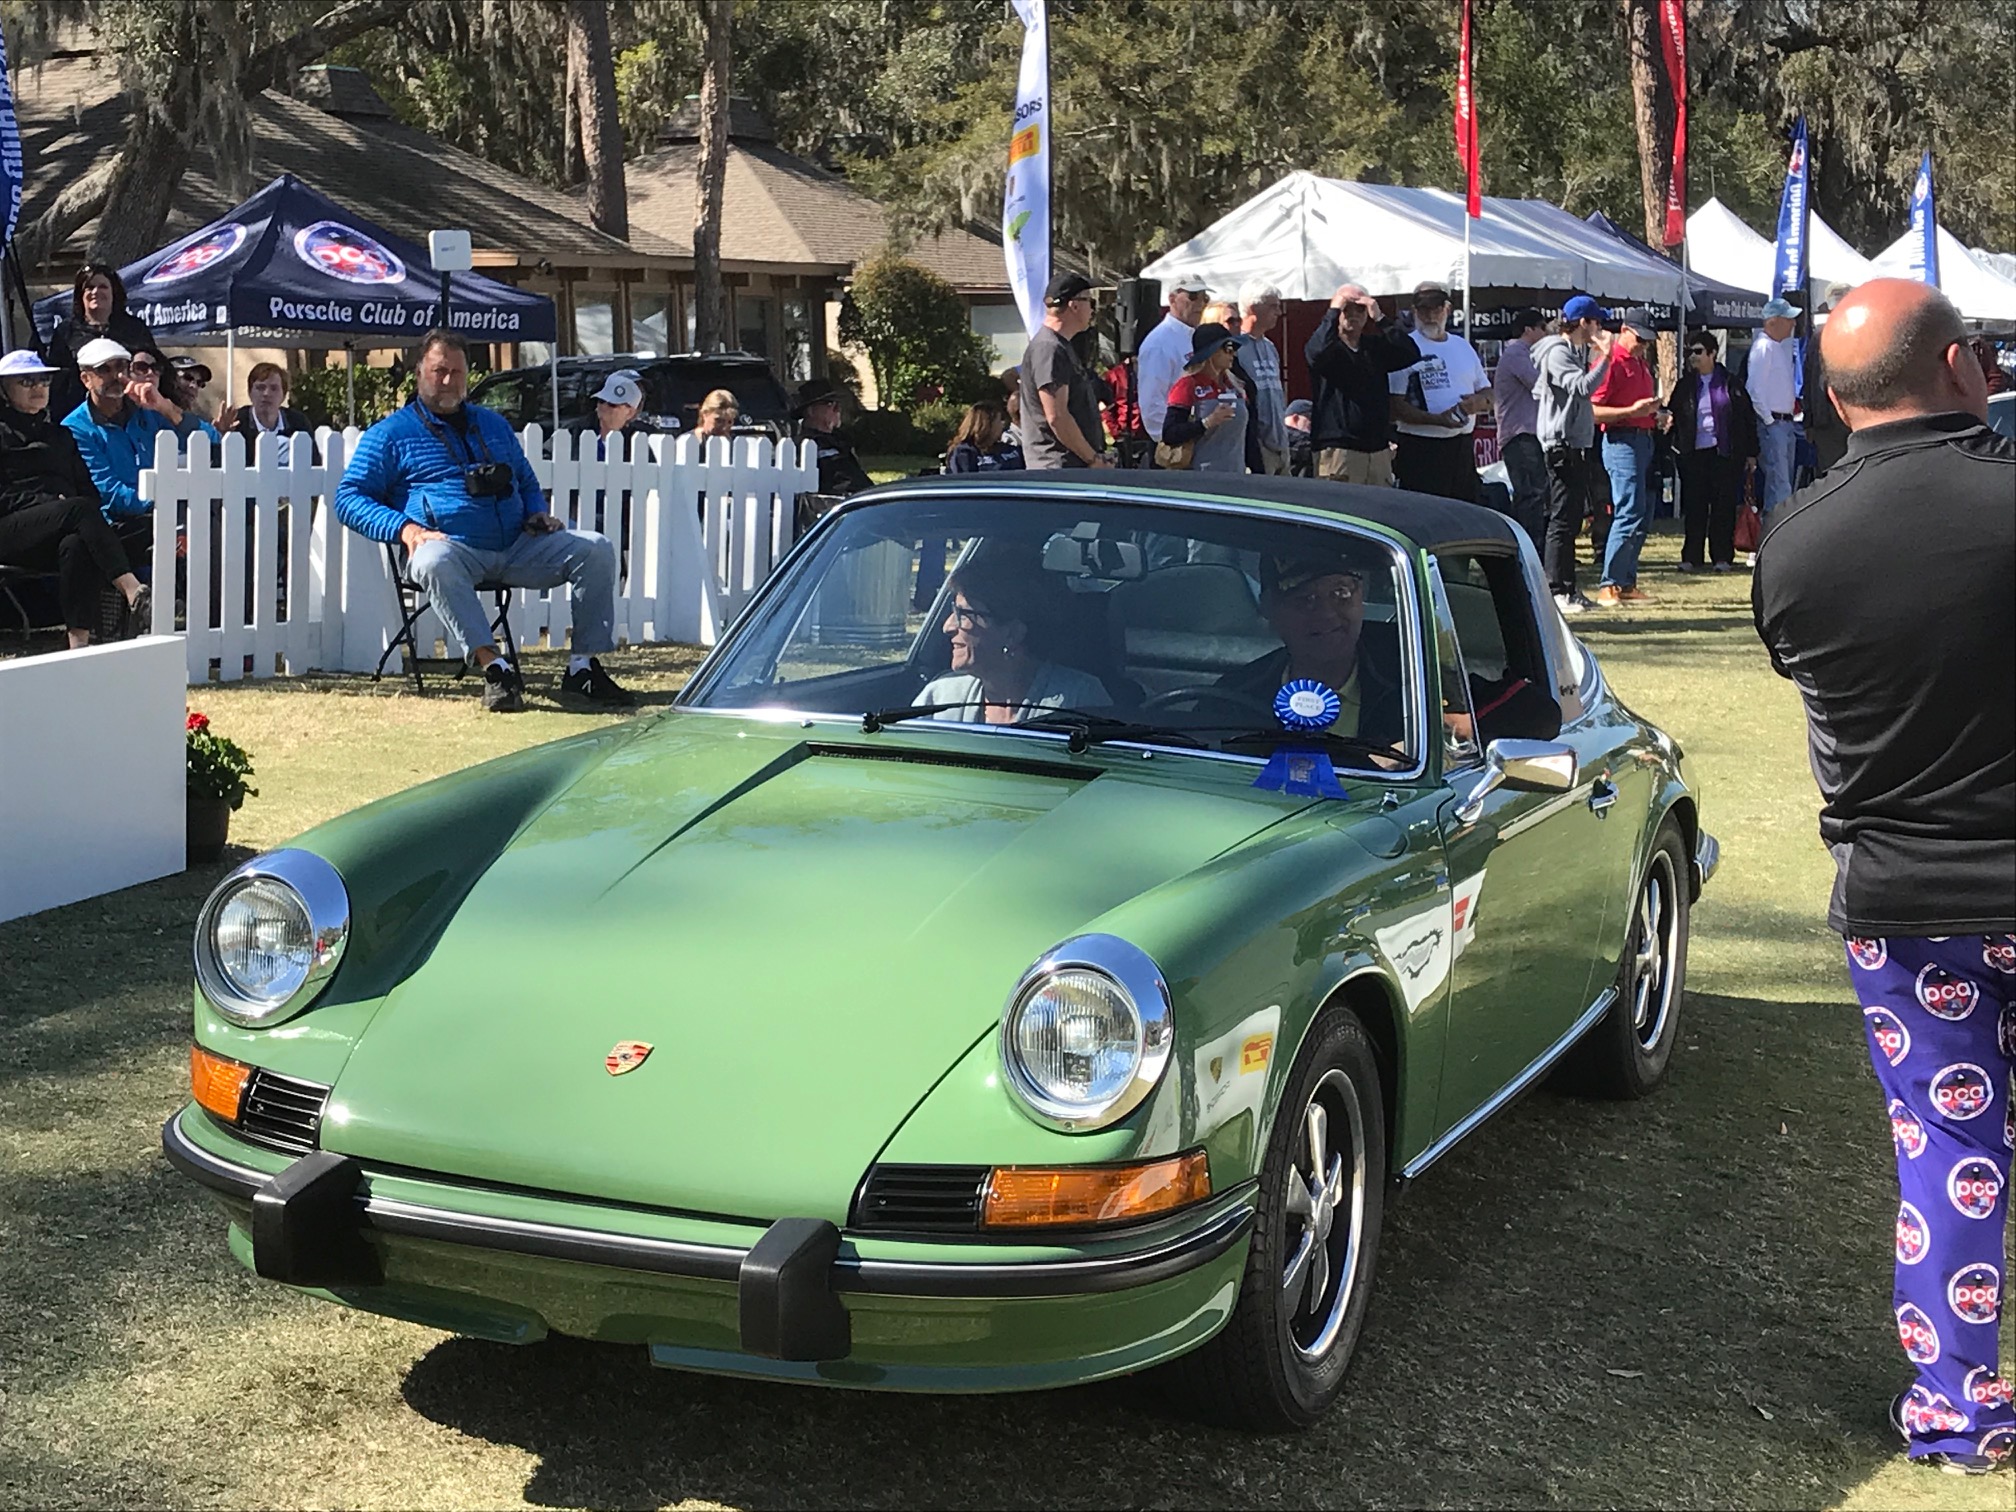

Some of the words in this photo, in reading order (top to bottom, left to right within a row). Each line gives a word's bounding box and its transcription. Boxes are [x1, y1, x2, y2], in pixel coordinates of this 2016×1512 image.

[153, 297, 207, 326] America
[269, 297, 352, 322] Porsche
[360, 302, 406, 327] Club
[412, 304, 436, 328] of
[439, 305, 520, 331] merica
[1474, 438, 1500, 468] GRI
[1924, 980, 1972, 1003] pca
[1874, 1031, 1901, 1049] ca
[1937, 1085, 1985, 1103] pca
[1956, 1180, 2000, 1199] pca
[1955, 1286, 1999, 1304] pca
